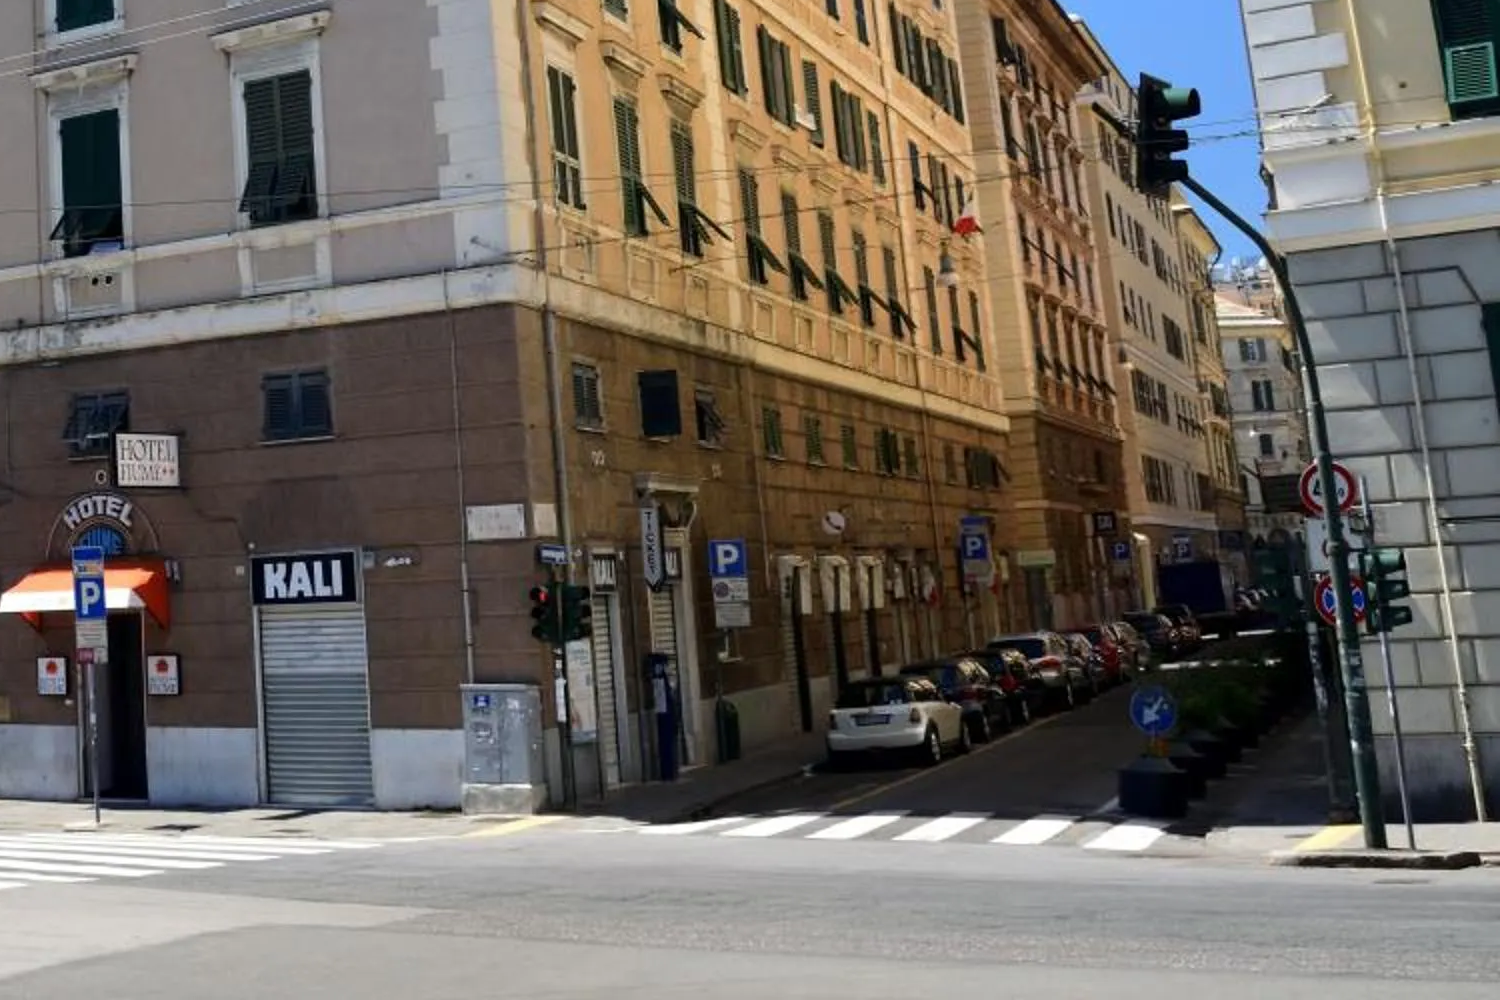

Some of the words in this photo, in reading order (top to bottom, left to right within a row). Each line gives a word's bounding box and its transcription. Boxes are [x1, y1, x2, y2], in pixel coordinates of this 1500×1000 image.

[119, 439, 175, 462] HOTEL
[63, 495, 133, 530] HOTEL
[643, 511, 657, 575] TICKET
[716, 544, 739, 574] P
[263, 559, 344, 599] KALI
[81, 581, 101, 616] P
